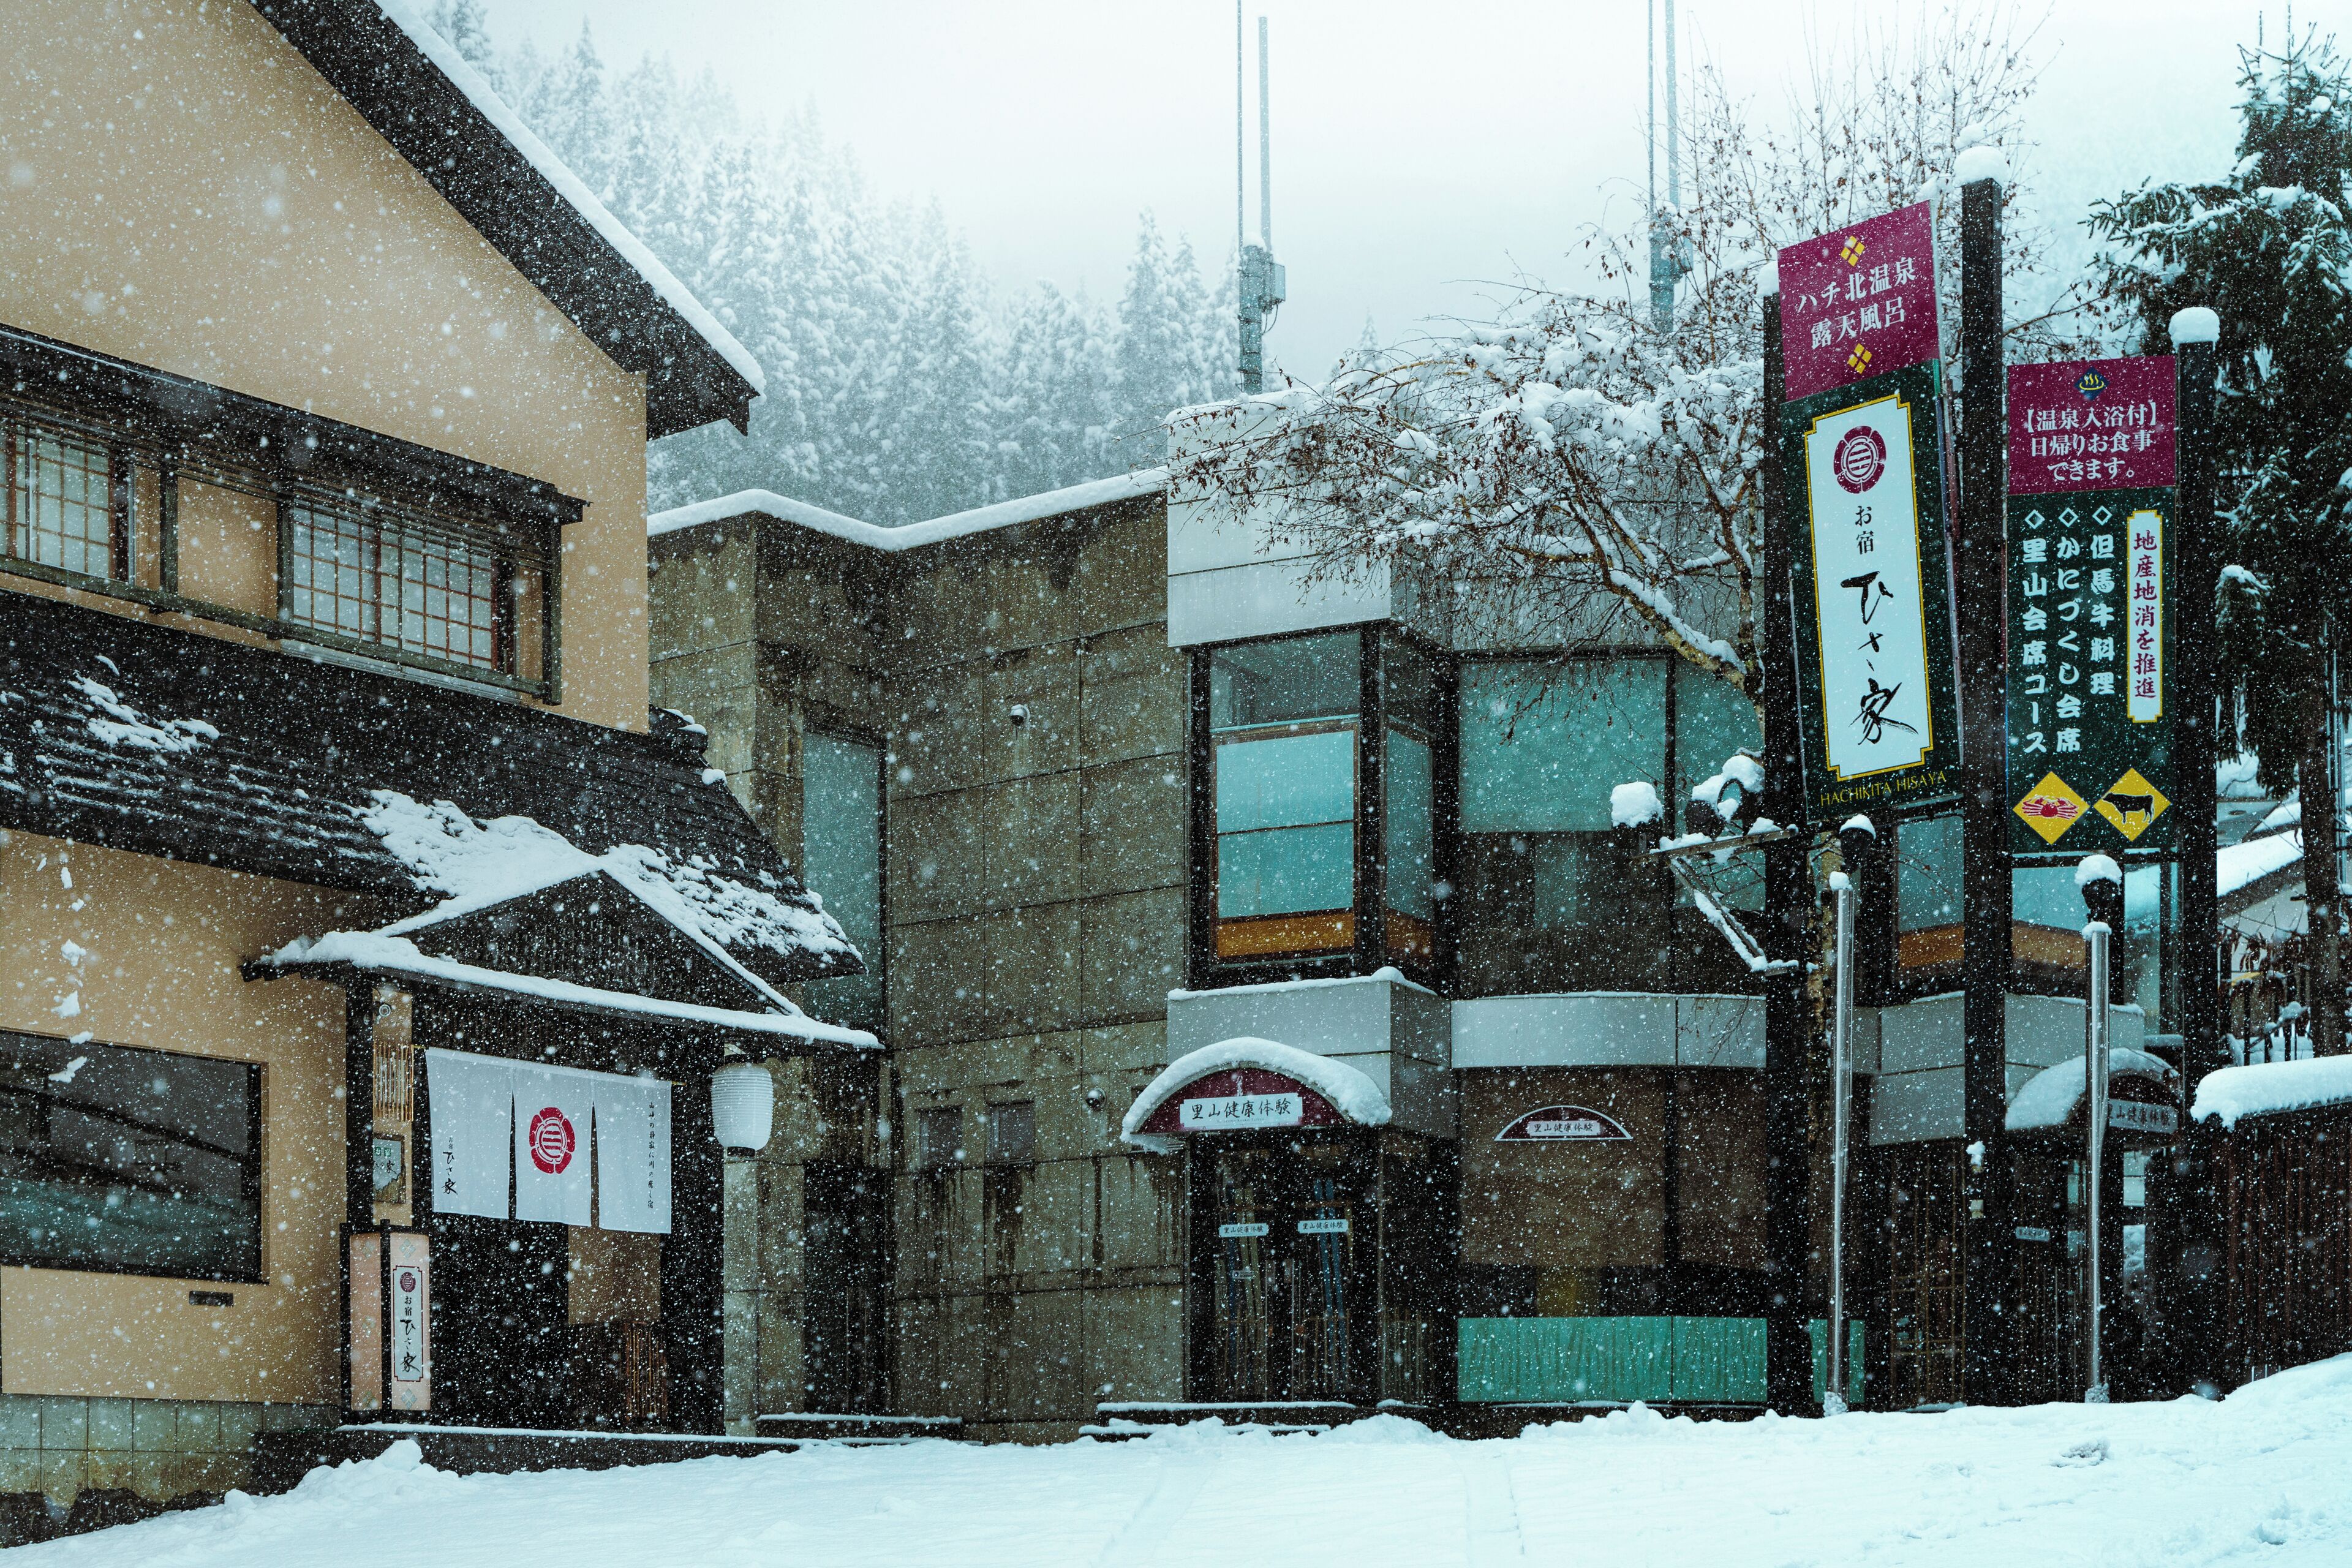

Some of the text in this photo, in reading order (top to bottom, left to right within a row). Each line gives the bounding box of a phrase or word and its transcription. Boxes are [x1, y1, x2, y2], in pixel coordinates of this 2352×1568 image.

[1796, 257, 1916, 312] ハチ北温泉
[1811, 296, 1905, 350] 露天風呂
[2031, 429, 2155, 457] 日帰りお食事
[2048, 458, 2135, 481] できます。
[1854, 505, 1874, 556] お宿
[2133, 529, 2157, 699] 地産地消を推進
[1840, 570, 1919, 745] ひさ家
[1820, 770, 1947, 806] HACHIKITA HISAYA
[1191, 1098, 1291, 1120] 里山健康体験
